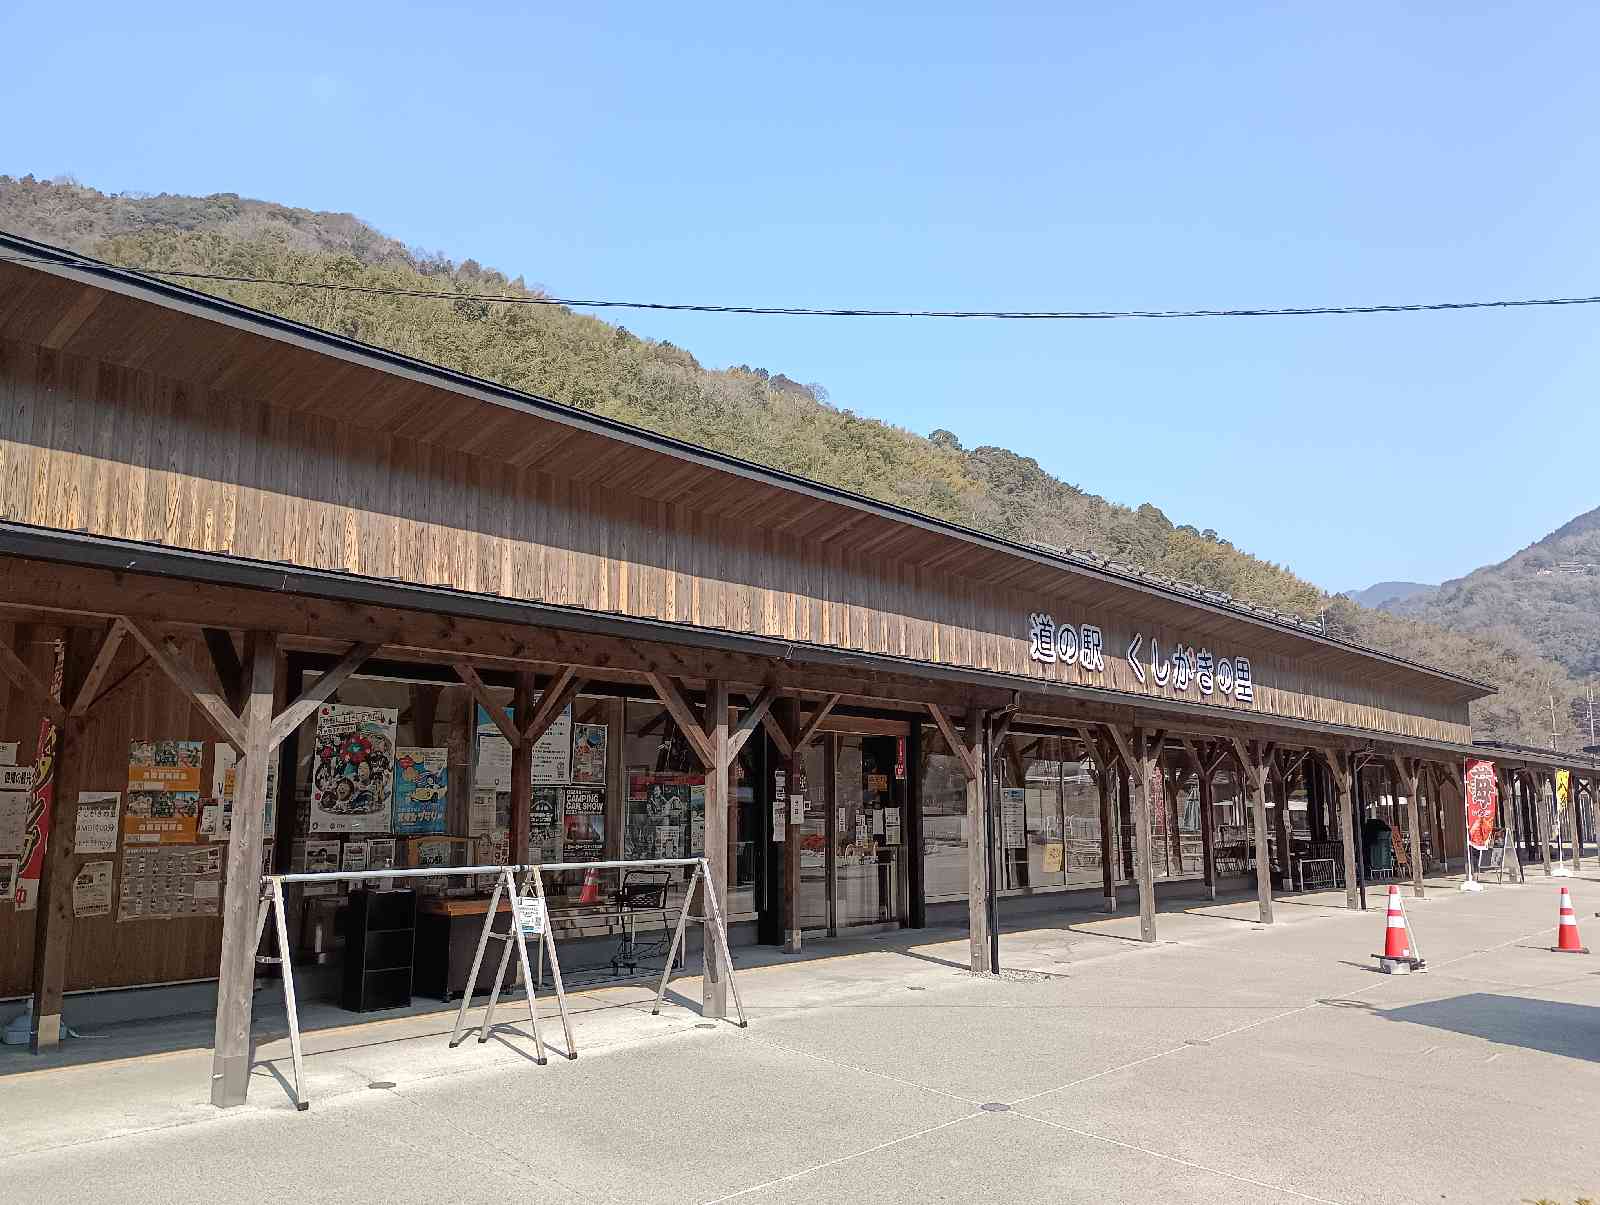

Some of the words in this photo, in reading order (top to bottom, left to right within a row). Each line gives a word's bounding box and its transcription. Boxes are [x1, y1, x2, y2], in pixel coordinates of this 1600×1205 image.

[1029, 612, 1105, 672] 道の駅
[566, 794, 599, 803] CAMPING
[567, 802, 581, 811] CAR
[582, 802, 603, 811] SHOW
